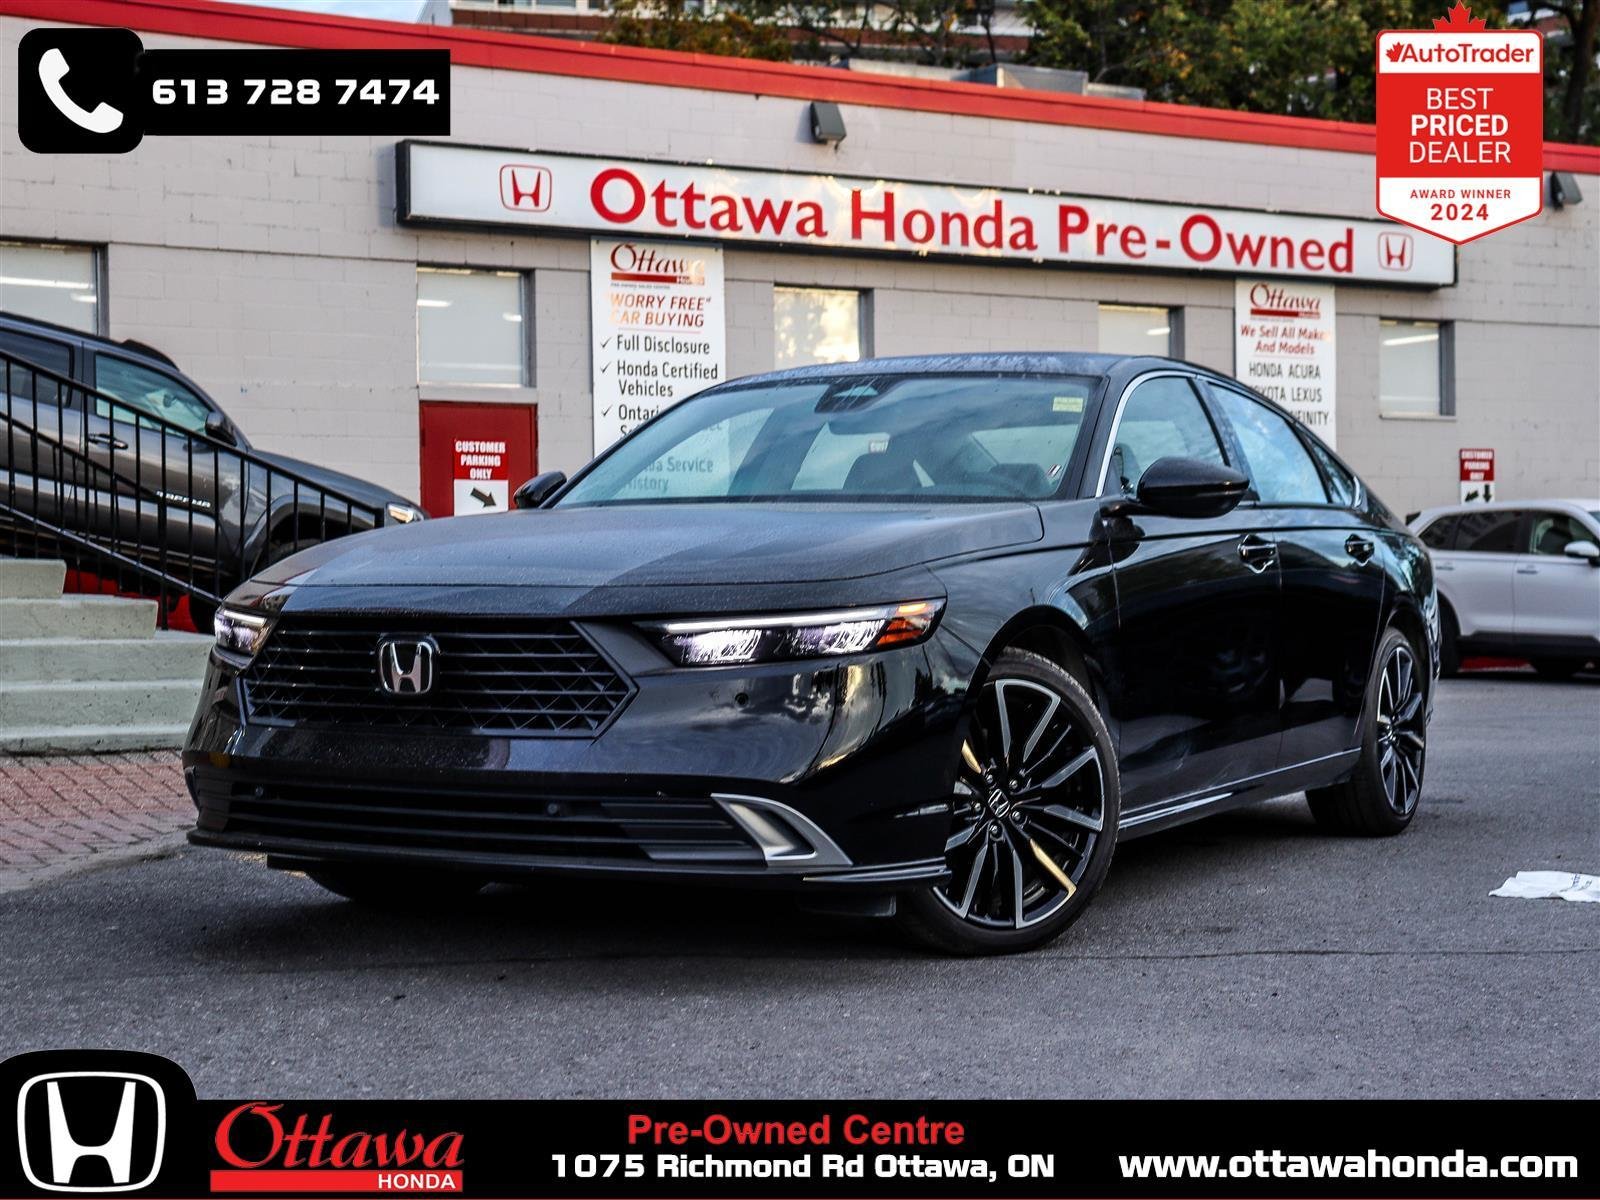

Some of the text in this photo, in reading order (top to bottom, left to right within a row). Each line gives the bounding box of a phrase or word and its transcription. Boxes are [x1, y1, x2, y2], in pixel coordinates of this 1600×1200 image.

[590, 168, 828, 238] Ottawa
[851, 189, 1038, 251] Honda
[1250, 281, 1321, 310] Ottawa
[610, 310, 704, 327] AR BUYING
[1240, 325, 1332, 342] We Sell All Make
[617, 335, 710, 355] Full Disclosure
[1256, 341, 1315, 355] And Models
[617, 360, 718, 380] Honda Certified
[1249, 362, 1321, 379] HONDA ACURA
[619, 380, 674, 398] Vehicles
[1291, 387, 1323, 403] LEXUS
[618, 404, 661, 421] Ontari
[455, 440, 506, 454] CUSTOMER
[460, 454, 501, 467] PARKING
[666, 456, 713, 473] Service
[470, 468, 493, 480] ONLY
[627, 476, 669, 493] istory
